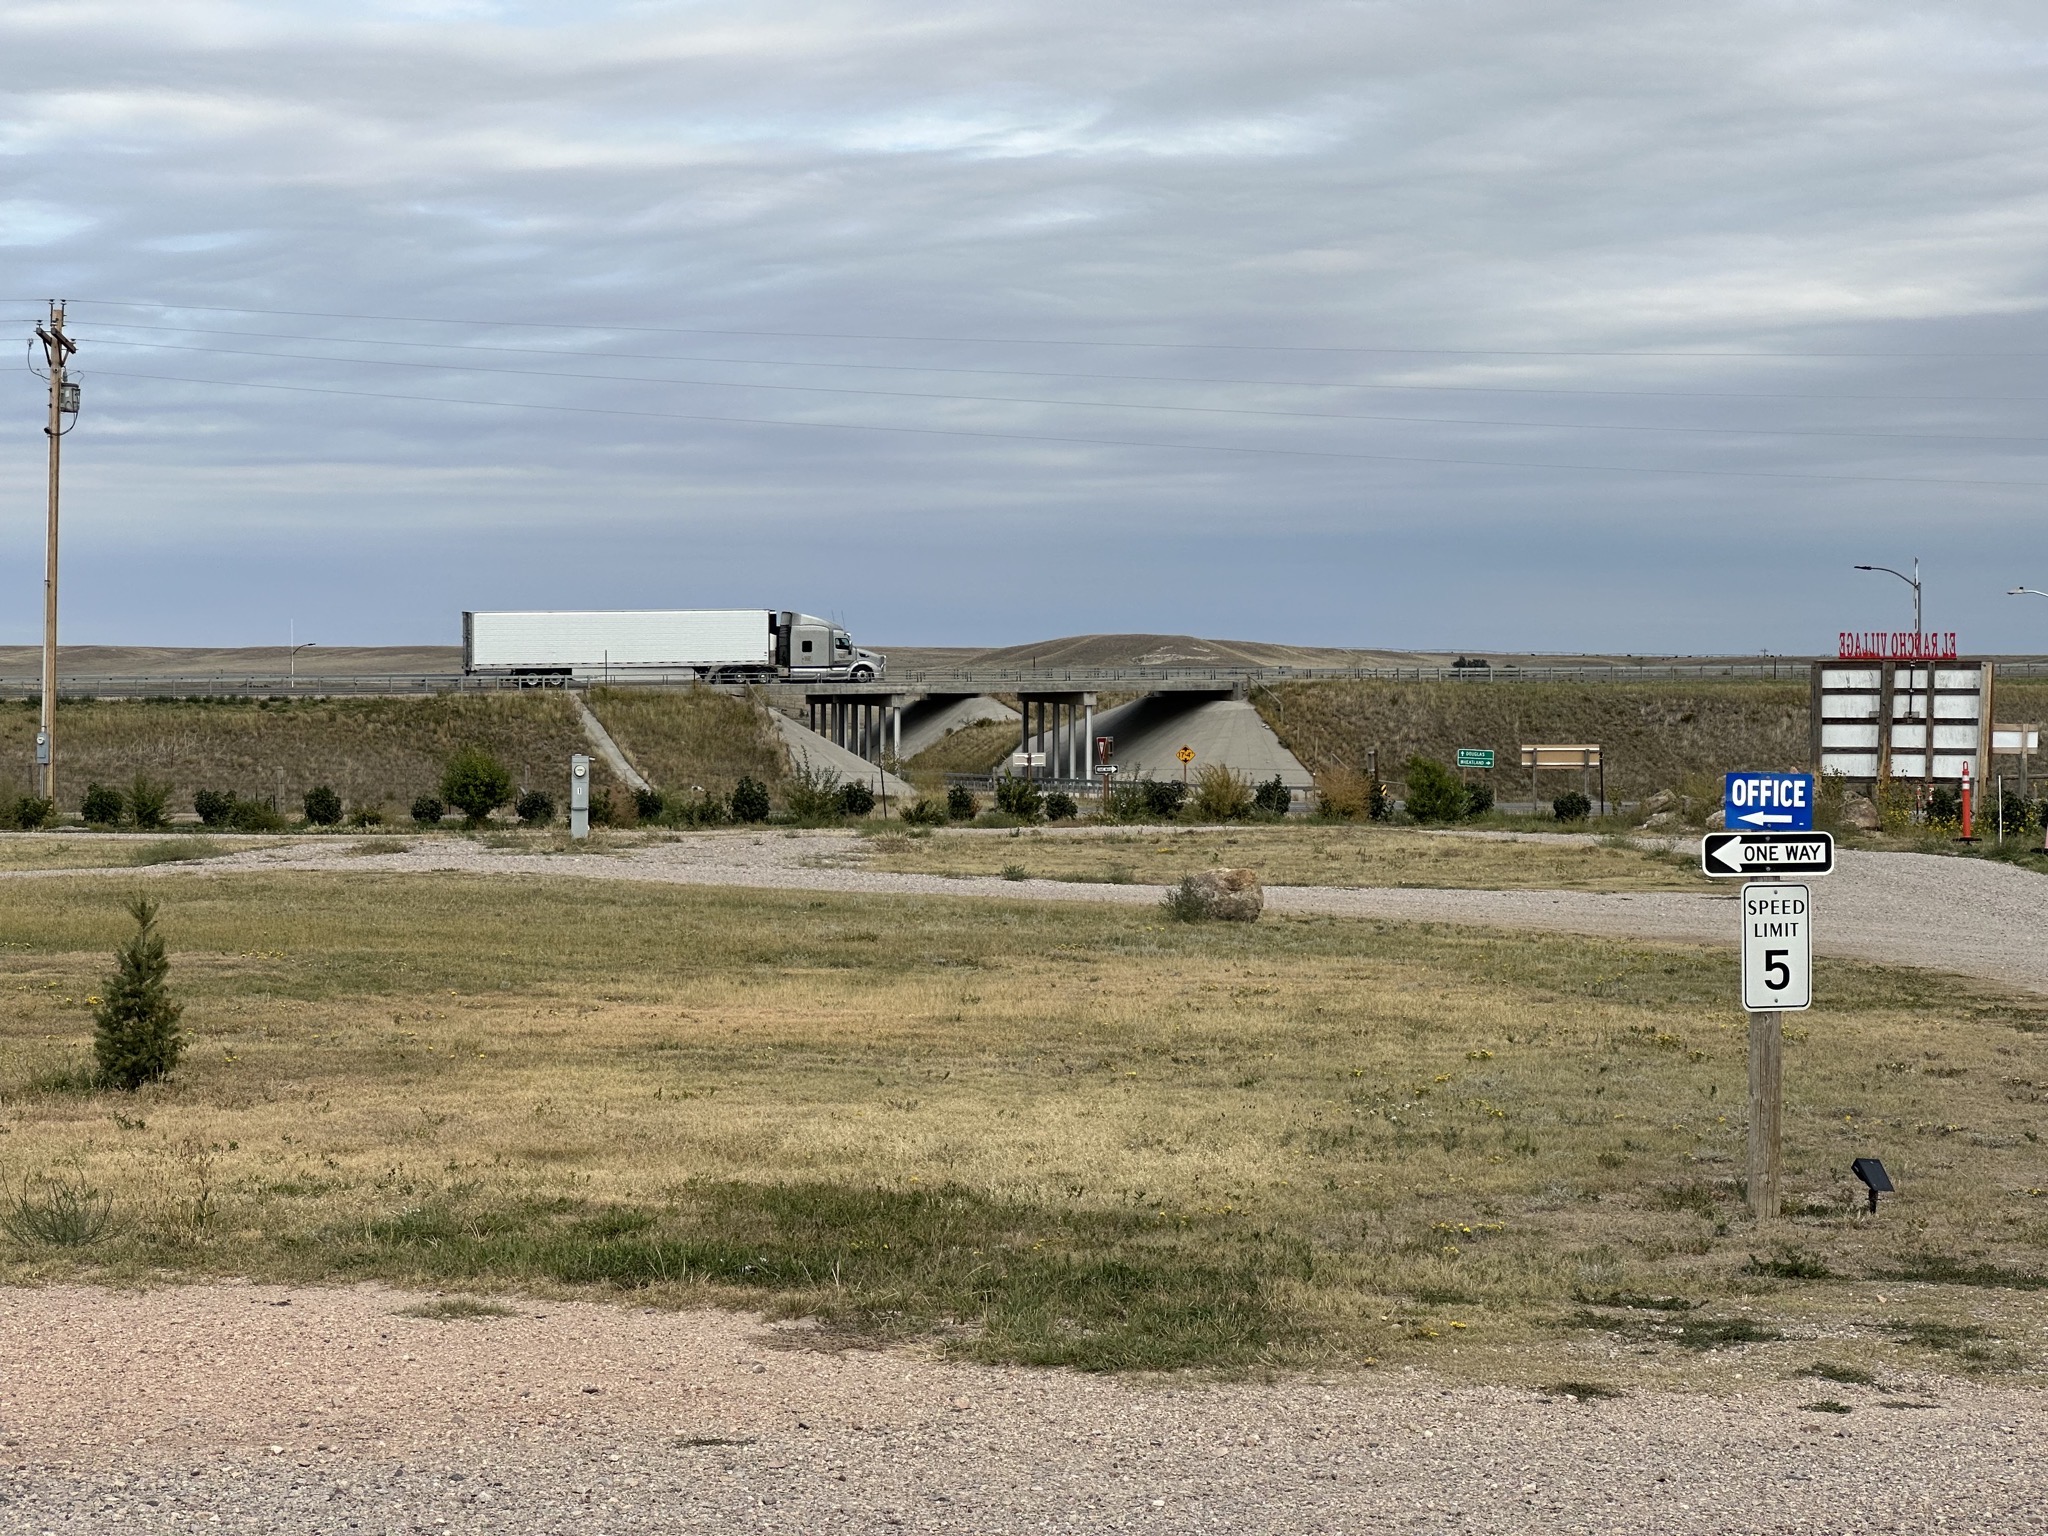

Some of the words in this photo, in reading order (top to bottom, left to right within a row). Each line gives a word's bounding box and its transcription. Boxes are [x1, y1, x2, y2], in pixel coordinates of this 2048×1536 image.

[1732, 778, 1806, 808] OFFICE
[1744, 846, 1779, 861] ONE
[1785, 845, 1821, 861] WAY
[1748, 900, 1805, 915] SPEED
[1754, 922, 1799, 938] LIMIT
[1764, 949, 1790, 990] 5
